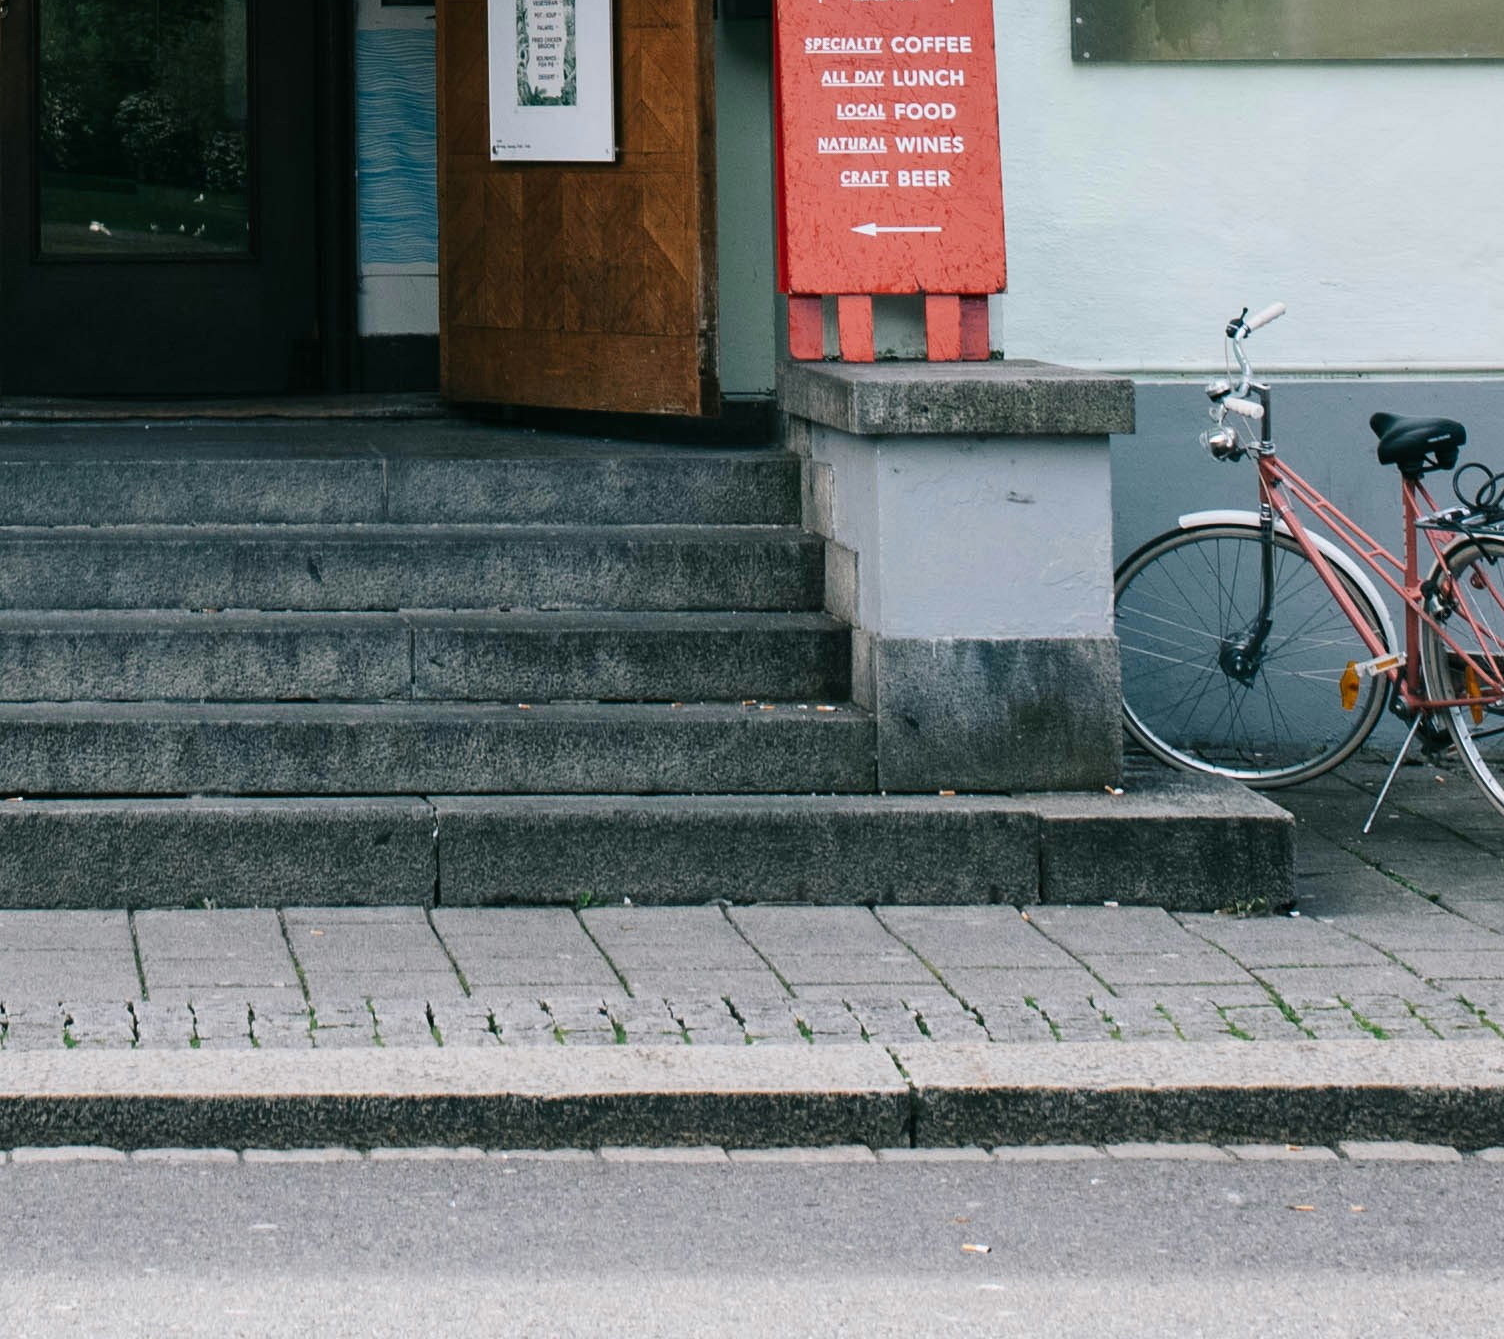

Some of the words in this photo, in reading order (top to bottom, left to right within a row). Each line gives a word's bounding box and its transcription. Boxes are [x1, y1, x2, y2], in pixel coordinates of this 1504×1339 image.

[804, 37, 883, 52] SPECIALTY
[891, 36, 973, 54] COFFEE
[821, 70, 848, 85] ALL
[854, 70, 885, 85] DAY
[893, 70, 965, 87] LUNCH
[836, 103, 886, 119] LOCAL
[894, 103, 957, 120] FOOD
[818, 137, 888, 152] NATURAL
[895, 136, 965, 153] WINES
[840, 170, 889, 185] CRAFT
[897, 170, 952, 187] BEER
